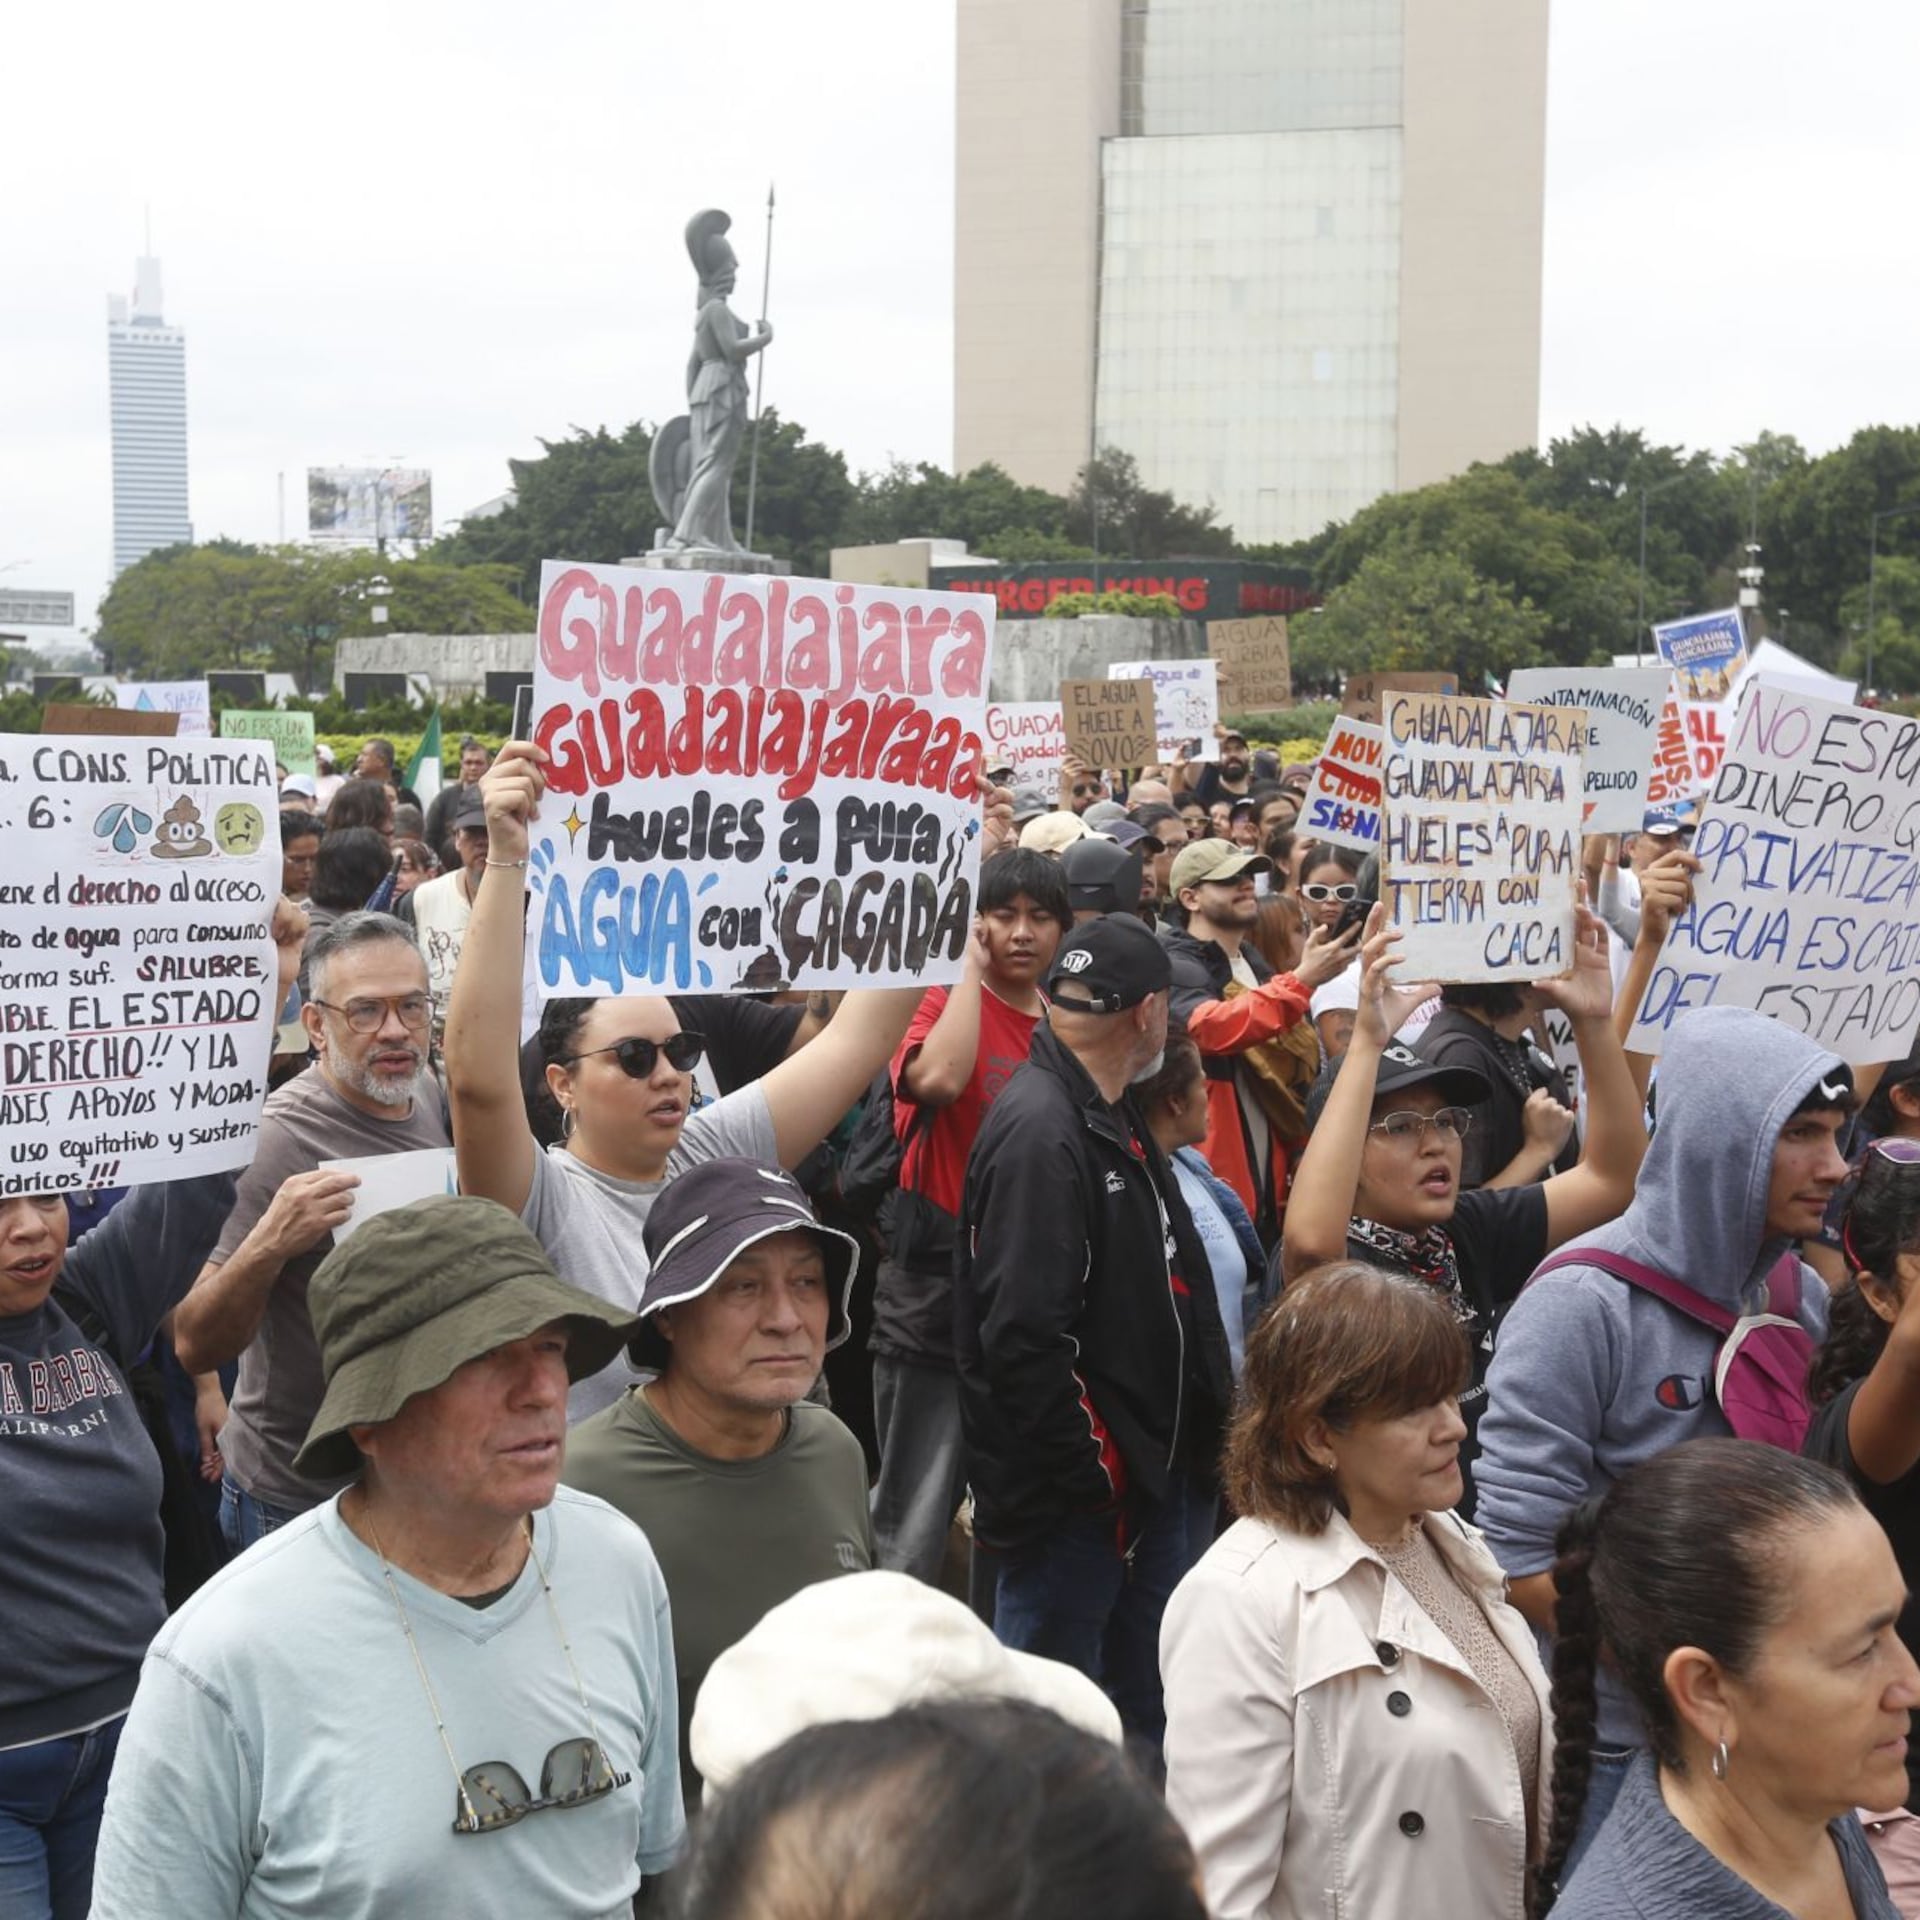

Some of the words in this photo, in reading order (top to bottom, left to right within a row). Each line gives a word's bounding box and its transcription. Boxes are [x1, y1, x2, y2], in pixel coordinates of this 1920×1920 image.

[540, 568, 986, 707] Guadalajara
[1214, 619, 1283, 644] AGUA
[1074, 685, 1098, 706] EL
[1101, 683, 1138, 705] AGUA
[1528, 688, 1655, 728] NTAMINACIÓN
[986, 707, 1065, 741] GUADA
[1077, 710, 1124, 734] HUELE
[1132, 710, 1145, 730] A
[1390, 698, 1583, 758] GUADALAJARA
[1736, 690, 1811, 759] NO
[33, 746, 131, 784] CONS.
[147, 747, 271, 787] POLITICA
[1091, 735, 1135, 766] OVO
[1384, 754, 1565, 803] GUADALAJARA
[1712, 762, 1884, 833] DINERO
[588, 790, 764, 864] hueles
[779, 797, 821, 864] a
[834, 795, 941, 876] pura
[1387, 813, 1493, 867] HUELES
[1496, 812, 1511, 842] A
[1511, 824, 1573, 875] PURA
[1695, 819, 1920, 911] PRIVATIZA
[43, 871, 60, 905] el
[68, 874, 161, 906] derecho
[169, 870, 189, 902] al
[194, 878, 266, 902] acceso,
[1385, 878, 1485, 926] TIERRA
[1497, 878, 1540, 905] CON
[32, 925, 58, 948] de
[64, 926, 120, 958] agua
[134, 928, 178, 952] para
[539, 867, 691, 994] AGUA
[698, 902, 761, 947] con
[780, 870, 970, 982] CAGADA
[1484, 921, 1561, 968] CACA
[1668, 901, 1789, 963] AGUA
[0, 962, 58, 990] orma
[69, 961, 115, 987] suf.
[136, 955, 269, 984] SALUBRE,
[69, 995, 112, 1031] EL
[122, 989, 261, 1027] ESTADO
[181, 1036, 200, 1072] Y
[208, 1032, 238, 1070] LA
[68, 1086, 156, 1121] APOYOS
[170, 1081, 186, 1111] Y
[11, 1142, 49, 1163] uso
[60, 1130, 159, 1168] equitativo
[168, 1132, 184, 1154] y
